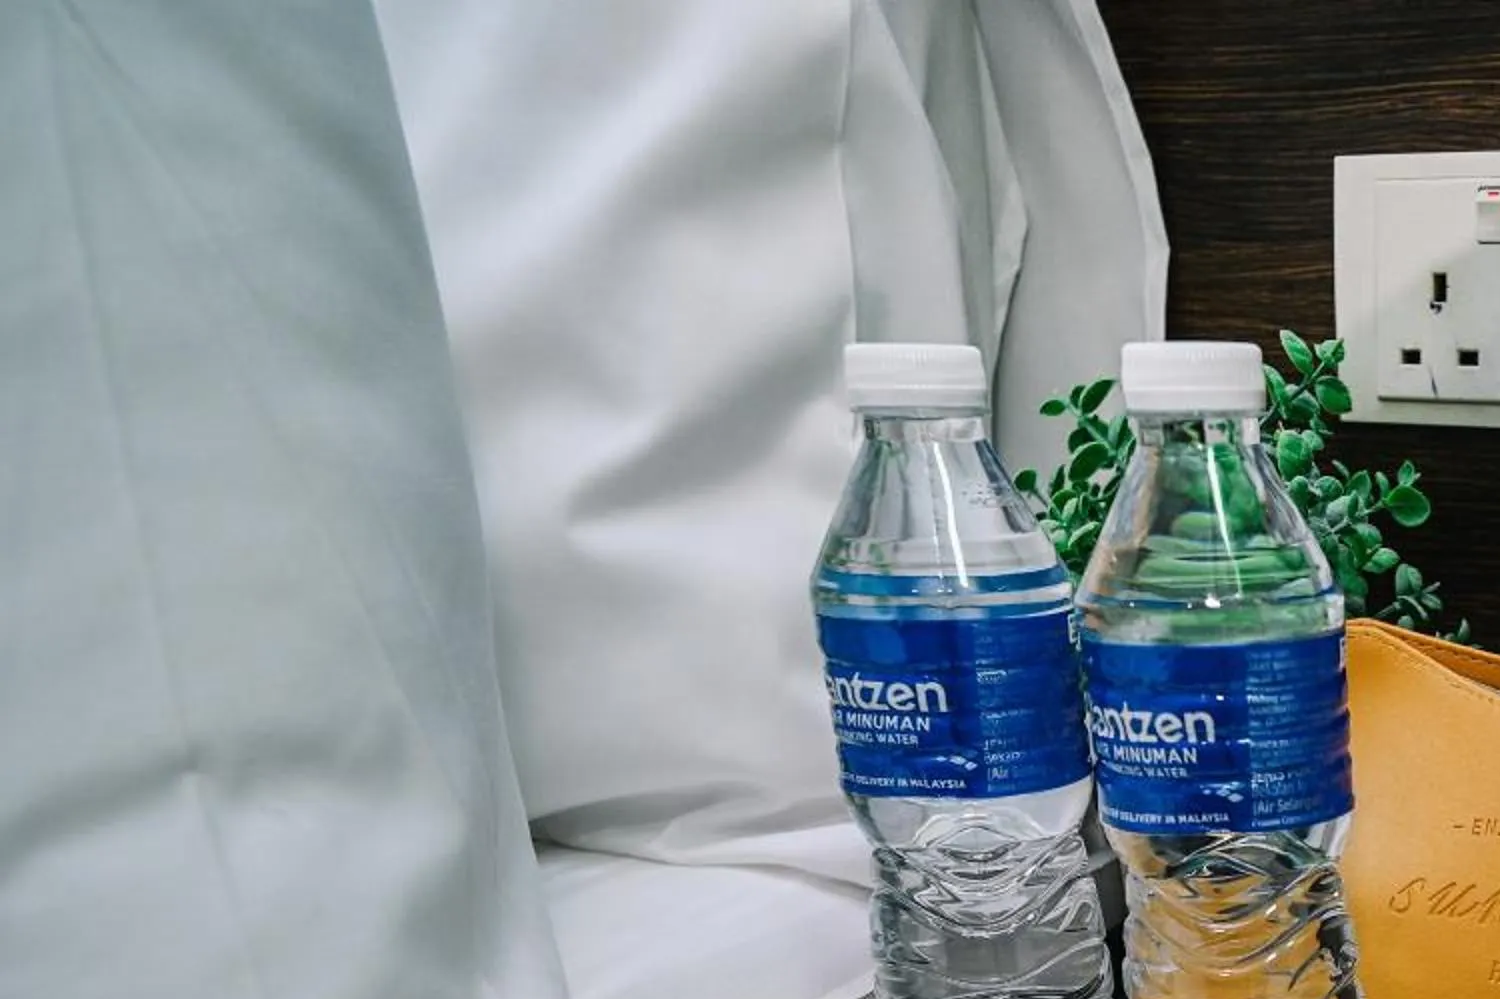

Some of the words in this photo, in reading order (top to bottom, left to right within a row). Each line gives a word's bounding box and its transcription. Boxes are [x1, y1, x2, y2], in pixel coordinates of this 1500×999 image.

[846, 711, 931, 732] MINUMAN
[876, 733, 919, 746] WATER
[1113, 745, 1198, 765] MINUMAN
[1144, 766, 1188, 778] WATER
[909, 778, 967, 789] MALAYSIA
[1178, 812, 1230, 824] MALAYSIA
